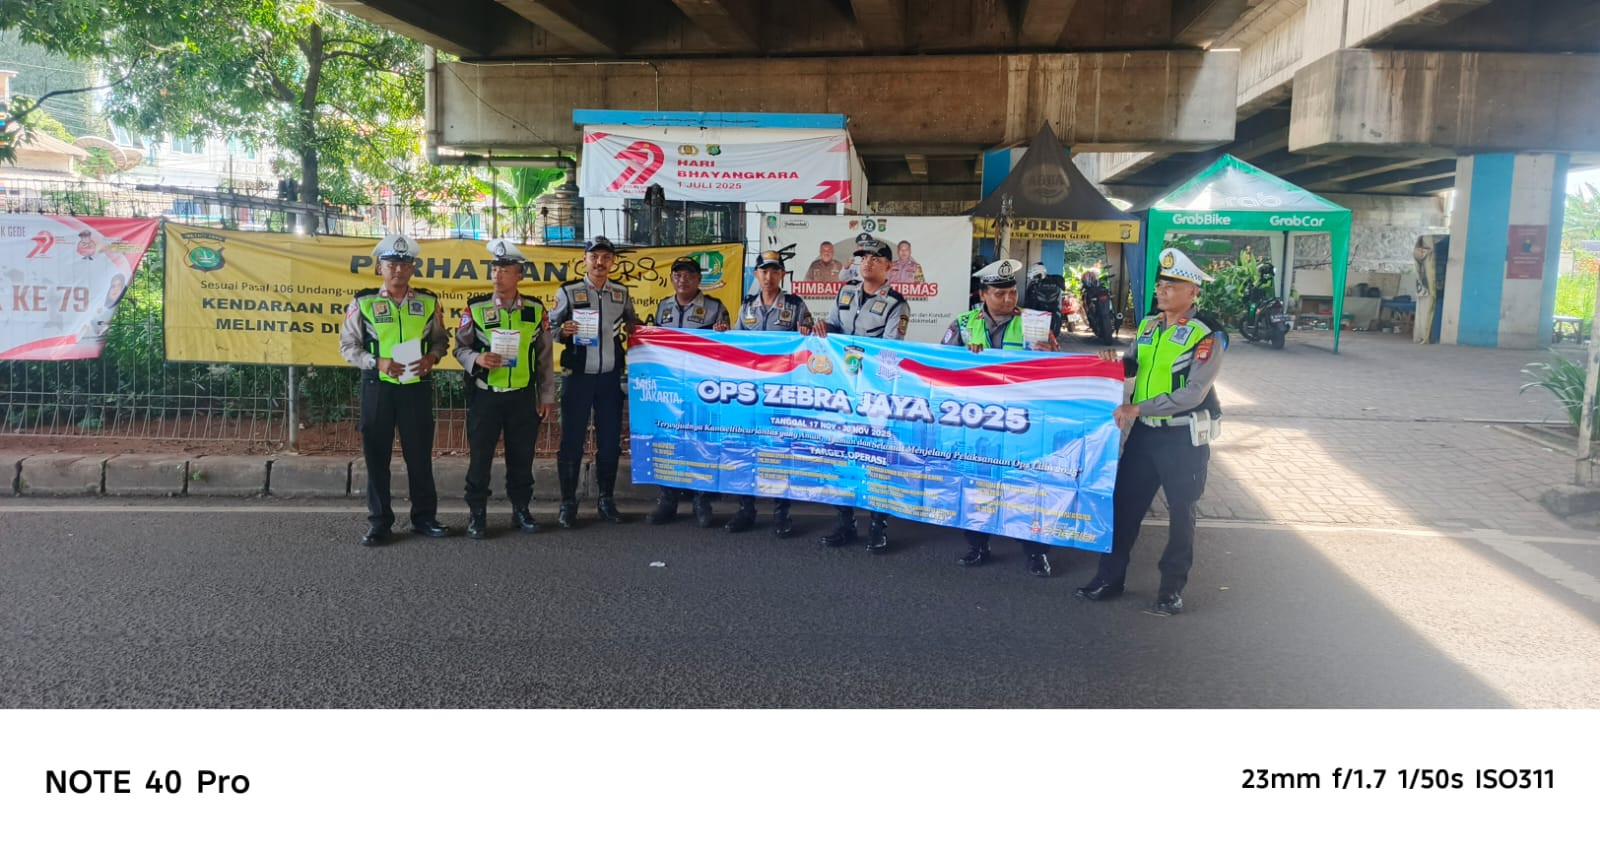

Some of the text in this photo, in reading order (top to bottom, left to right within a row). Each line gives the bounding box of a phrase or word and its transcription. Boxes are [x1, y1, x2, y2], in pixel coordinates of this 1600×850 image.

[677, 170, 799, 179] BHAYANGKARA
[1013, 219, 1078, 232] POLISI
[1172, 213, 1325, 227] GrabBike GrabCar
[7, 226, 26, 238] GEDE
[200, 279, 239, 291] Sesuai
[241, 282, 270, 292] Pasal
[273, 284, 294, 294] 106
[437, 291, 464, 300] ahun
[792, 282, 938, 295] HIMBAU TIBMAS
[12, 285, 90, 313] KE 79
[202, 297, 324, 315] KENDARAAN
[216, 318, 339, 334] MELINTAS DI
[697, 380, 1030, 434] OPS ZEBRA JAYA 2025
[770, 417, 807, 428] TANGGAL
[810, 446, 848, 458] TARGET
[847, 451, 888, 466] OPERASI
[952, 452, 1011, 466] Pelaksanaan
